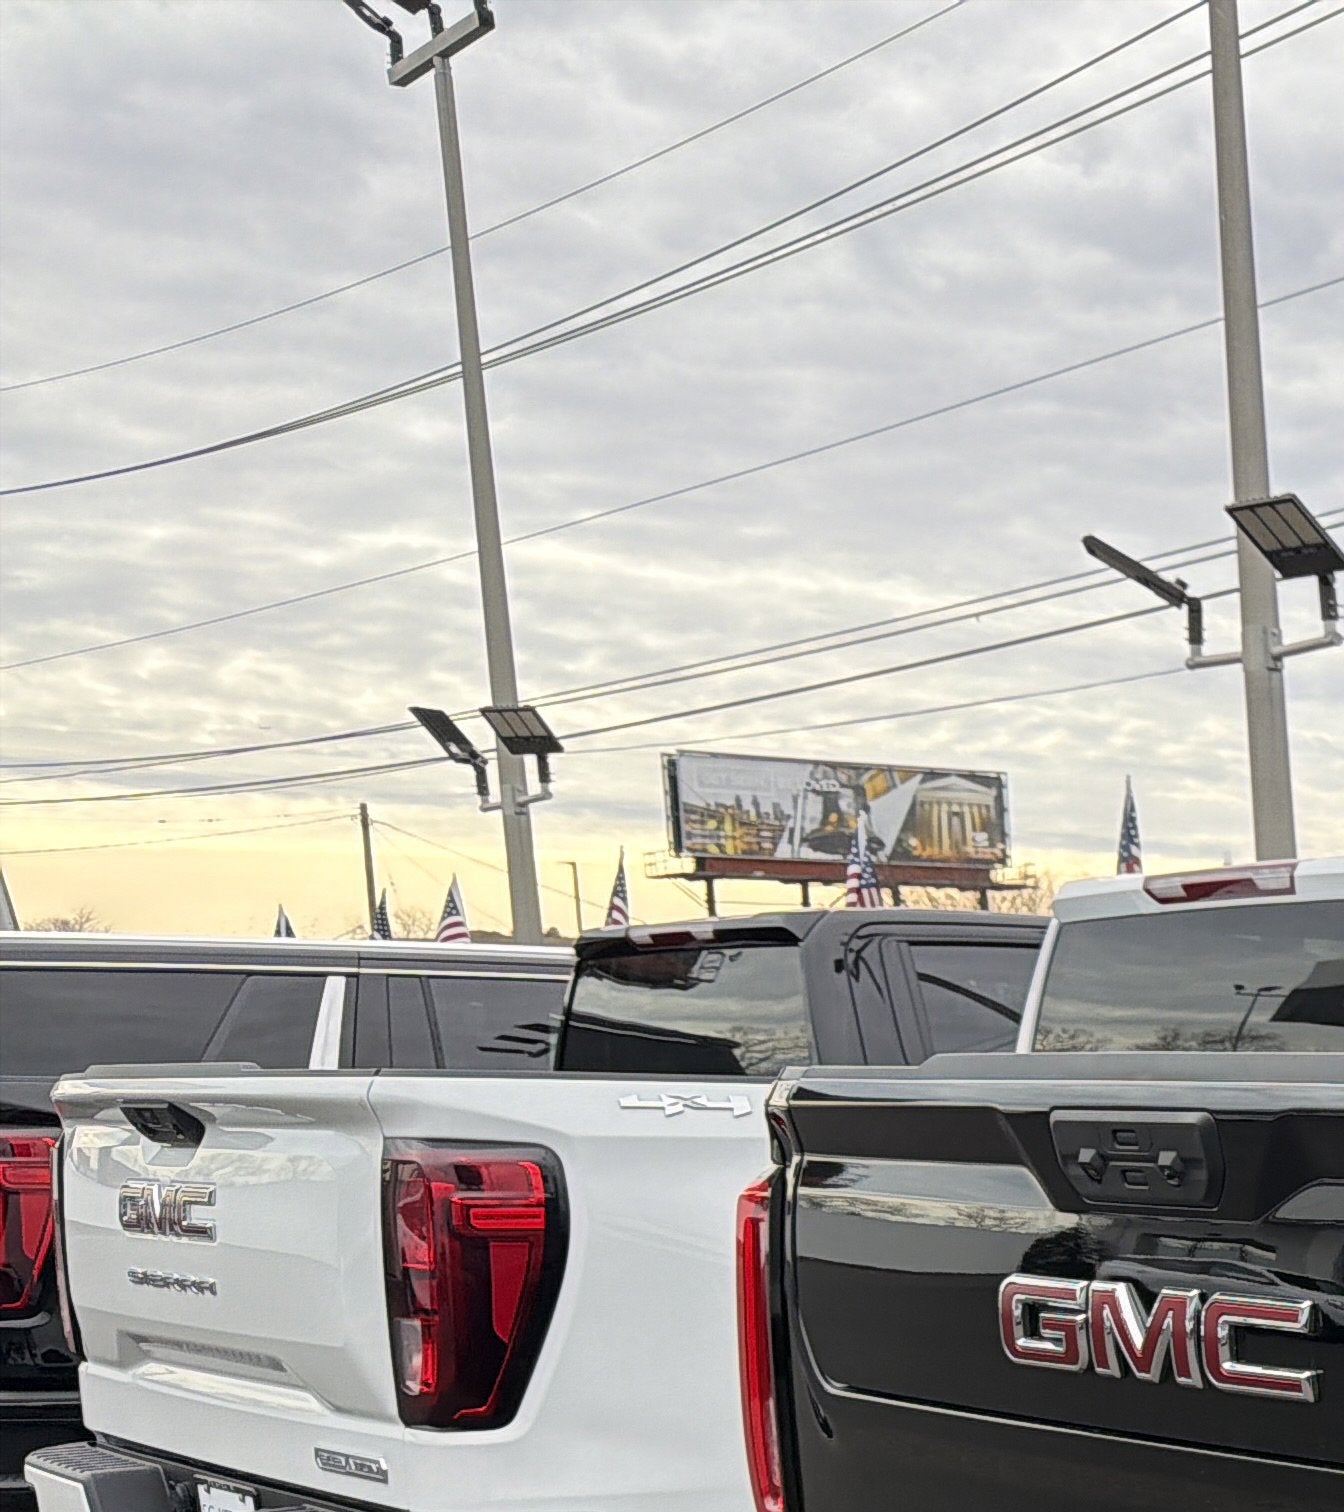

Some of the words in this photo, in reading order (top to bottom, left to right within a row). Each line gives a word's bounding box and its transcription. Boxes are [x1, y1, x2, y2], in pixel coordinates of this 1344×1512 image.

[119, 1178, 217, 1242] GMC
[127, 1267, 217, 1297] SIERRA
[999, 1273, 1321, 1403] GMC
